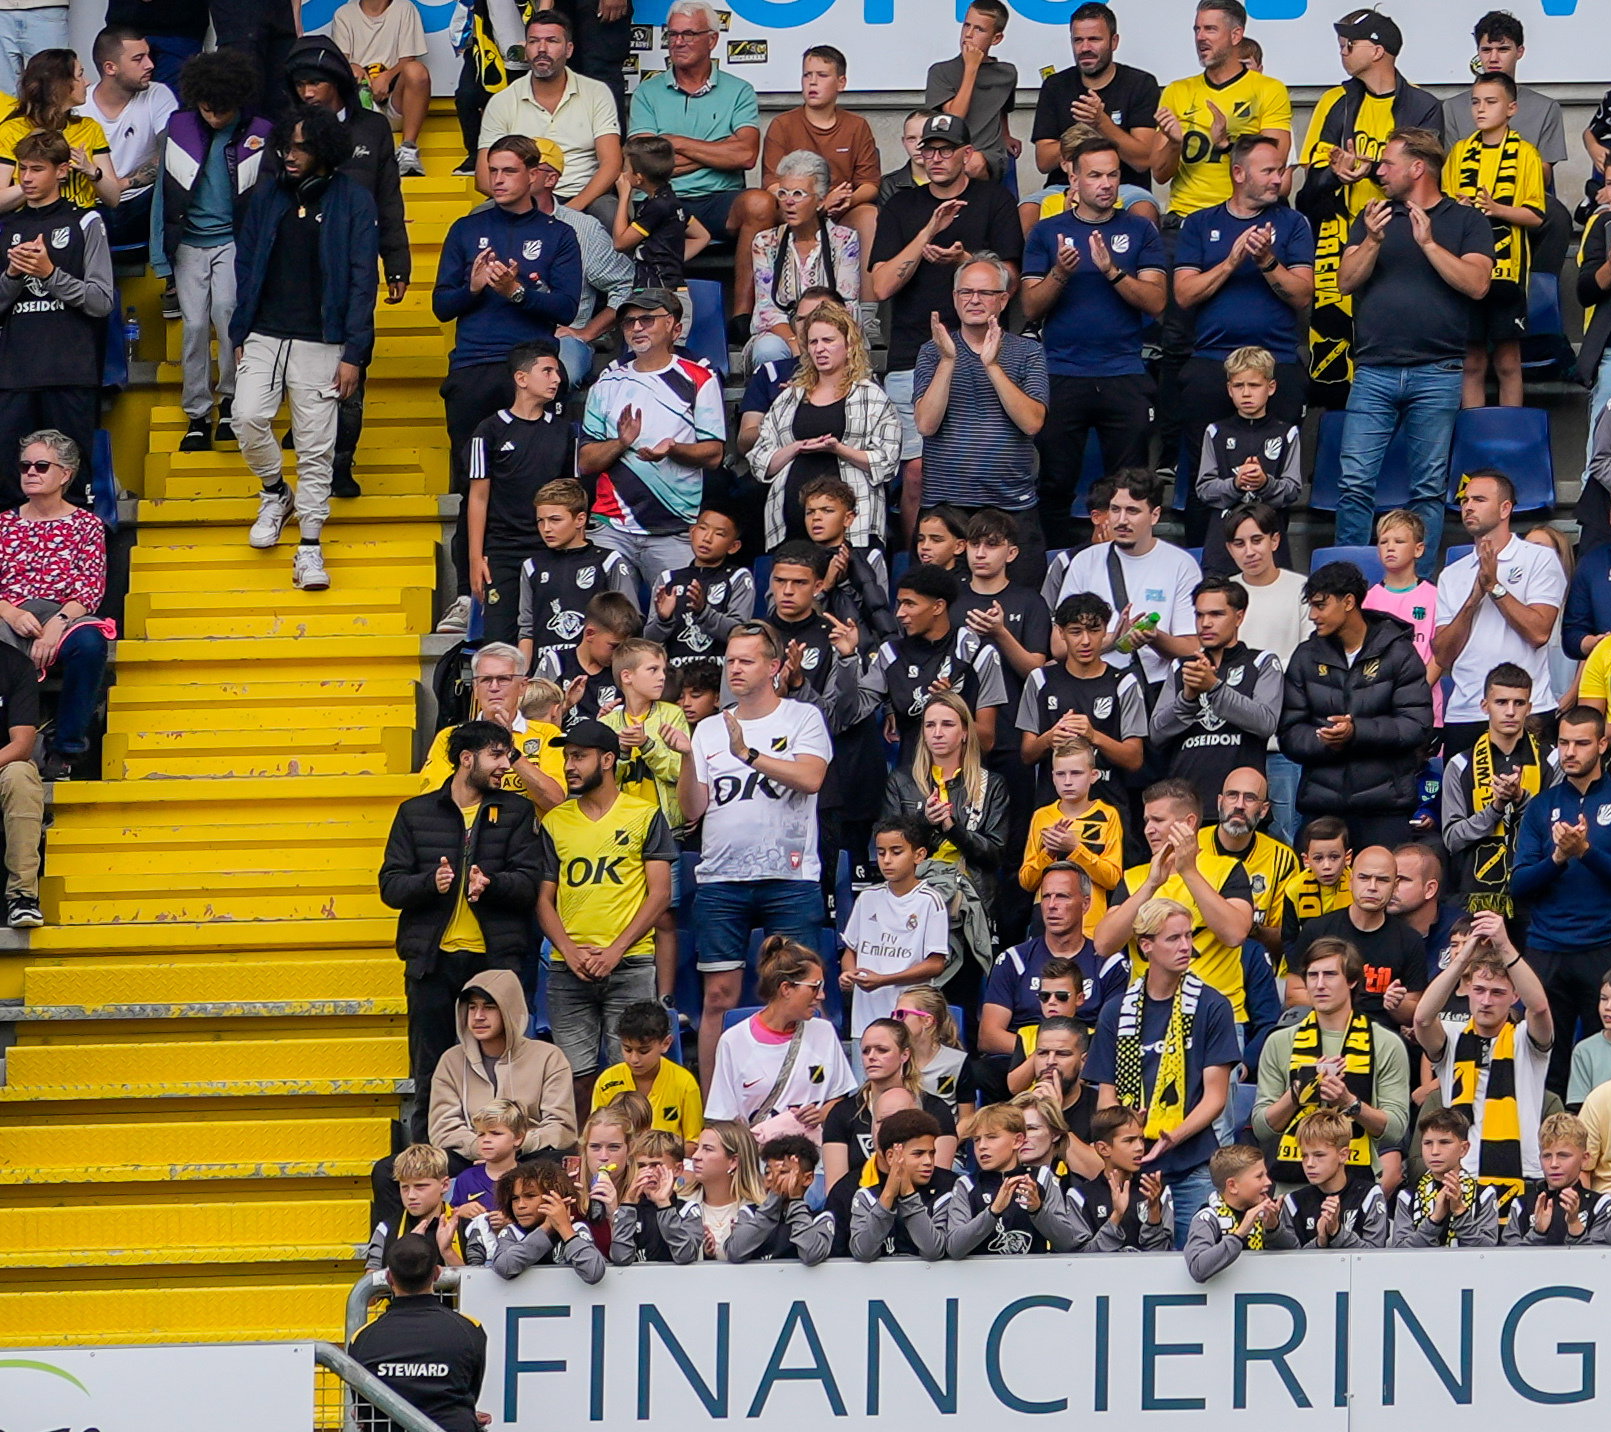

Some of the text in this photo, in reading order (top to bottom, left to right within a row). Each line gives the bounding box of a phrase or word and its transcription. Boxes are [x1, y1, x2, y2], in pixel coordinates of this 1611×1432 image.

[566, 855, 626, 888] OK
[861, 942, 912, 960] Emirates
[377, 1362, 450, 1378] STEWARD
